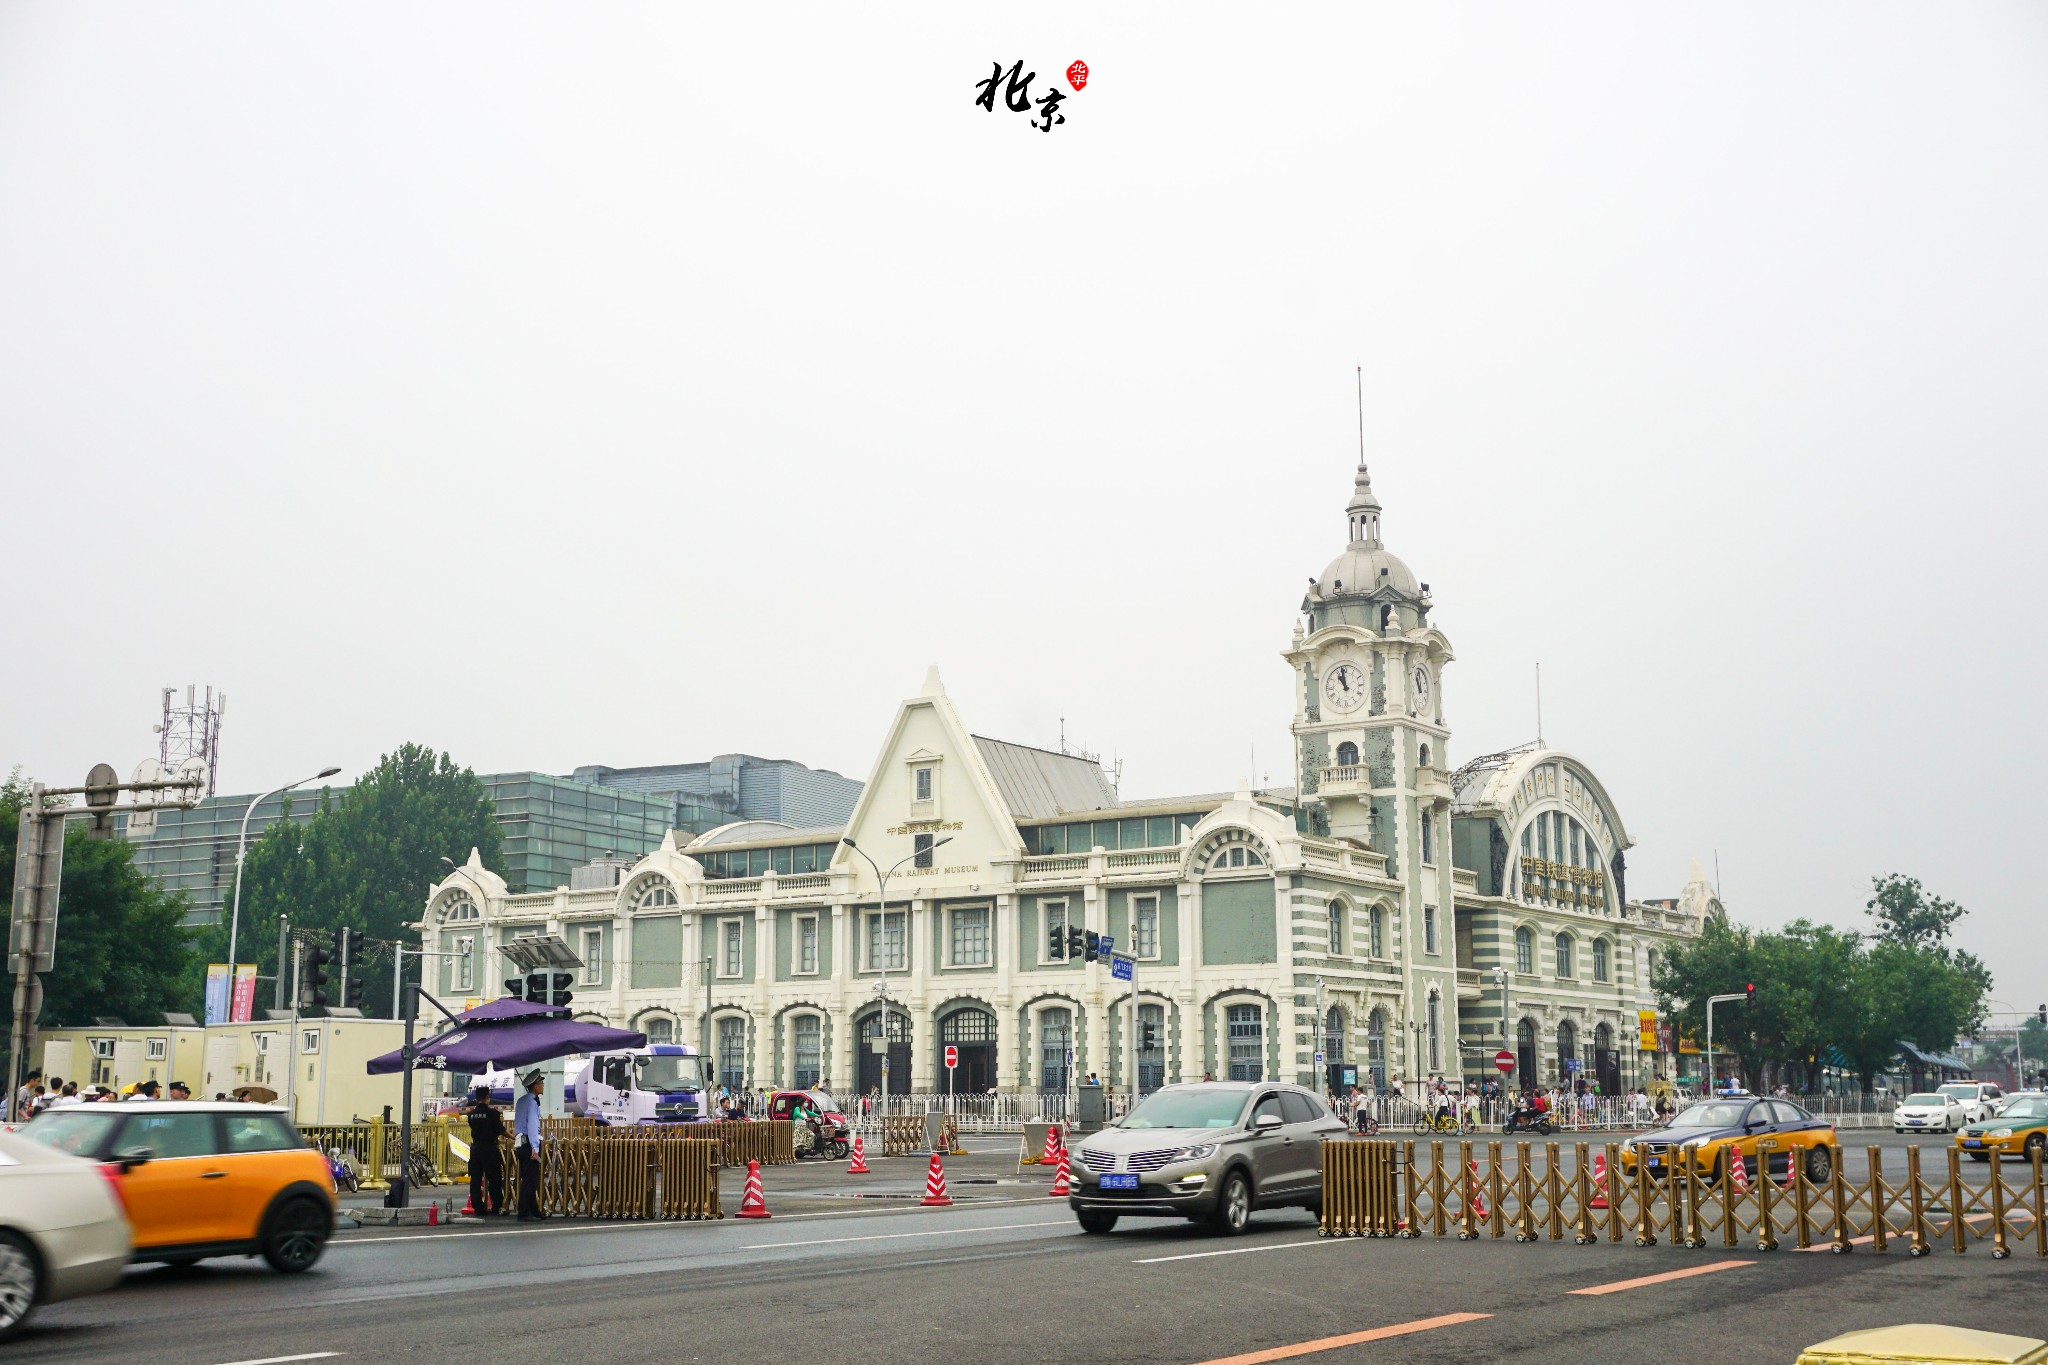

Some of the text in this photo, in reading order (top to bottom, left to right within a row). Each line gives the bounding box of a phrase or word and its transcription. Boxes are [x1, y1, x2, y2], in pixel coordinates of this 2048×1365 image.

[907, 868, 940, 877] RAILWAY
[944, 865, 979, 874] MUSEUM
[1521, 855, 1603, 889] 中国铁道博物馆
[1522, 882, 1545, 897] CHINA
